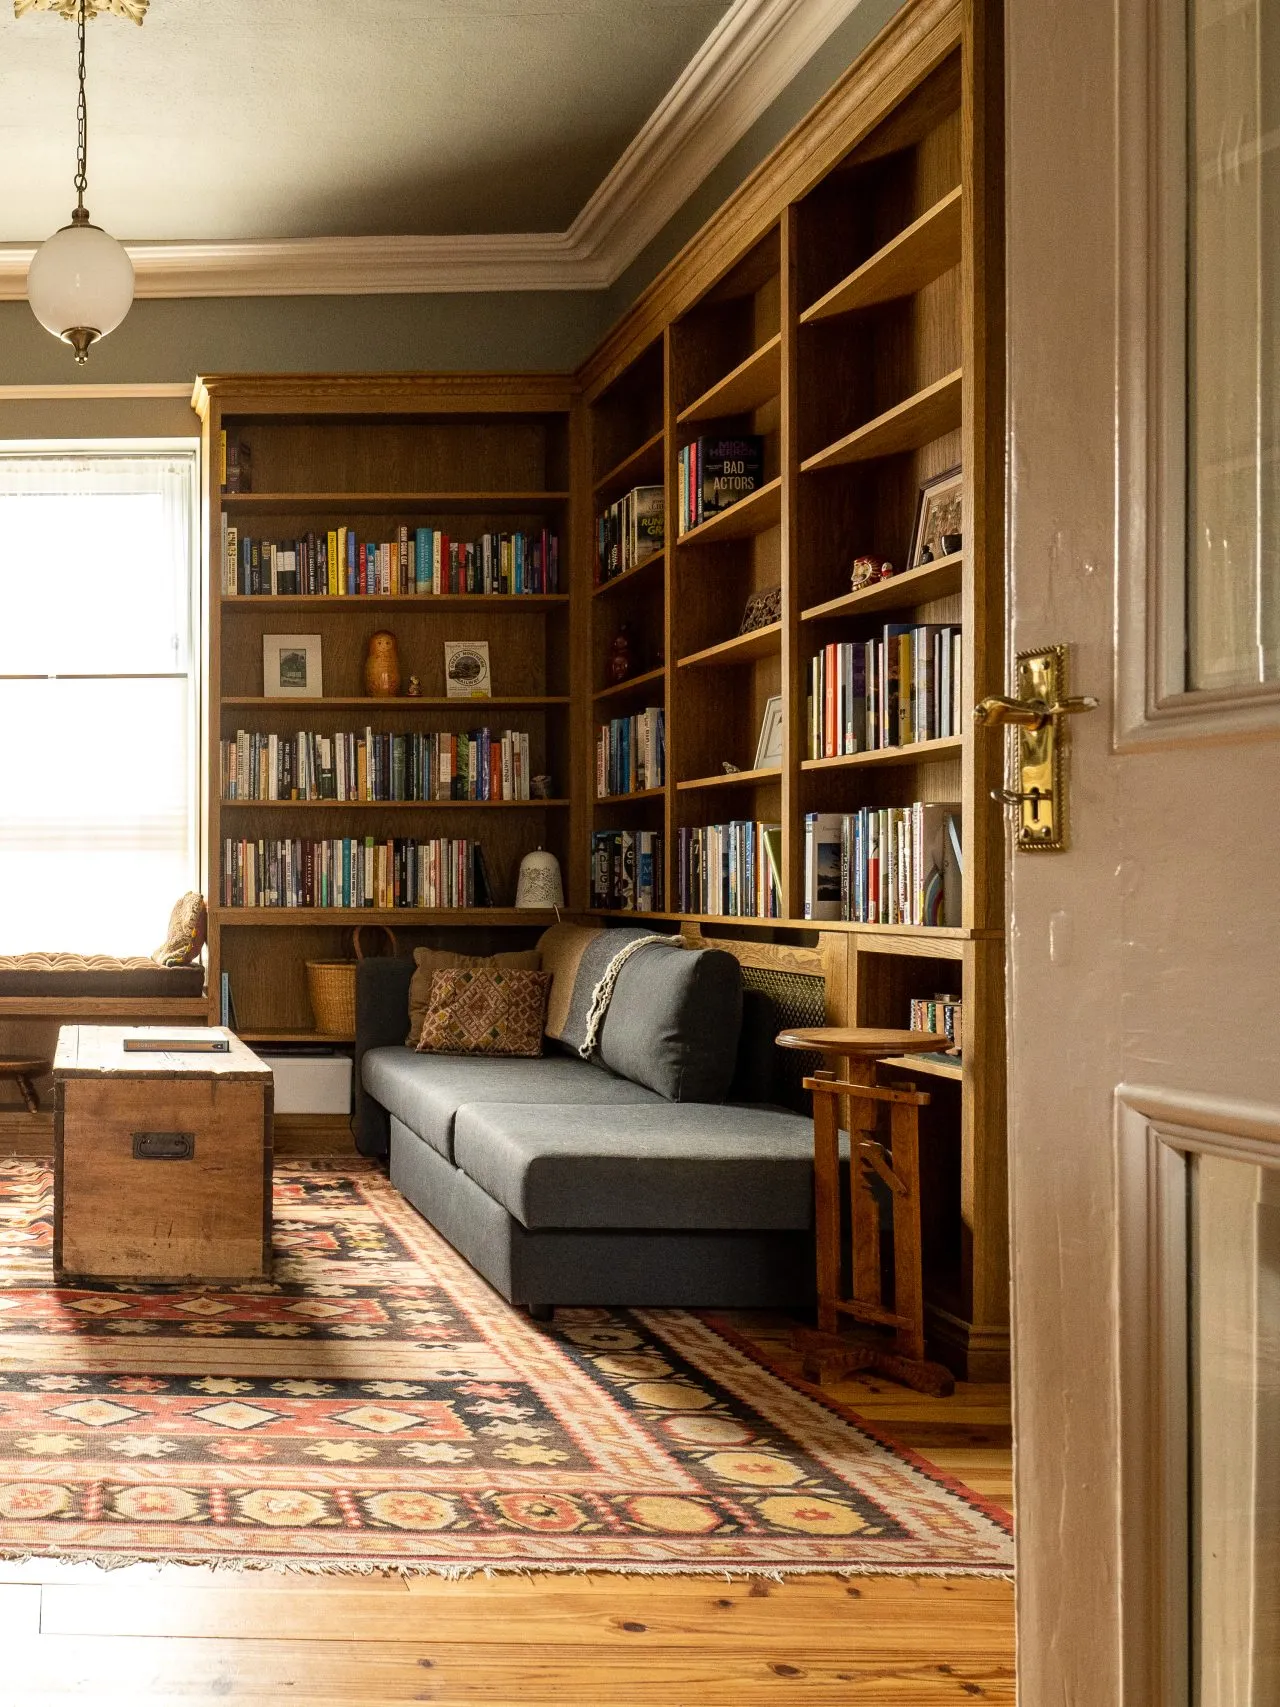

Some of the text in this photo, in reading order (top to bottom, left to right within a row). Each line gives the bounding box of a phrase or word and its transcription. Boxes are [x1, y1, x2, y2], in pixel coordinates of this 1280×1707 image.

[718, 440, 749, 448] MICK
[709, 448, 758, 457] HERRON
[723, 460, 745, 474] BAD
[713, 476, 755, 490] ACTORS
[400, 526, 408, 541] GROW
[400, 542, 408, 556] COOK
[400, 556, 408, 566] EAT
[450, 651, 486, 669] GREAT NORTHERN
